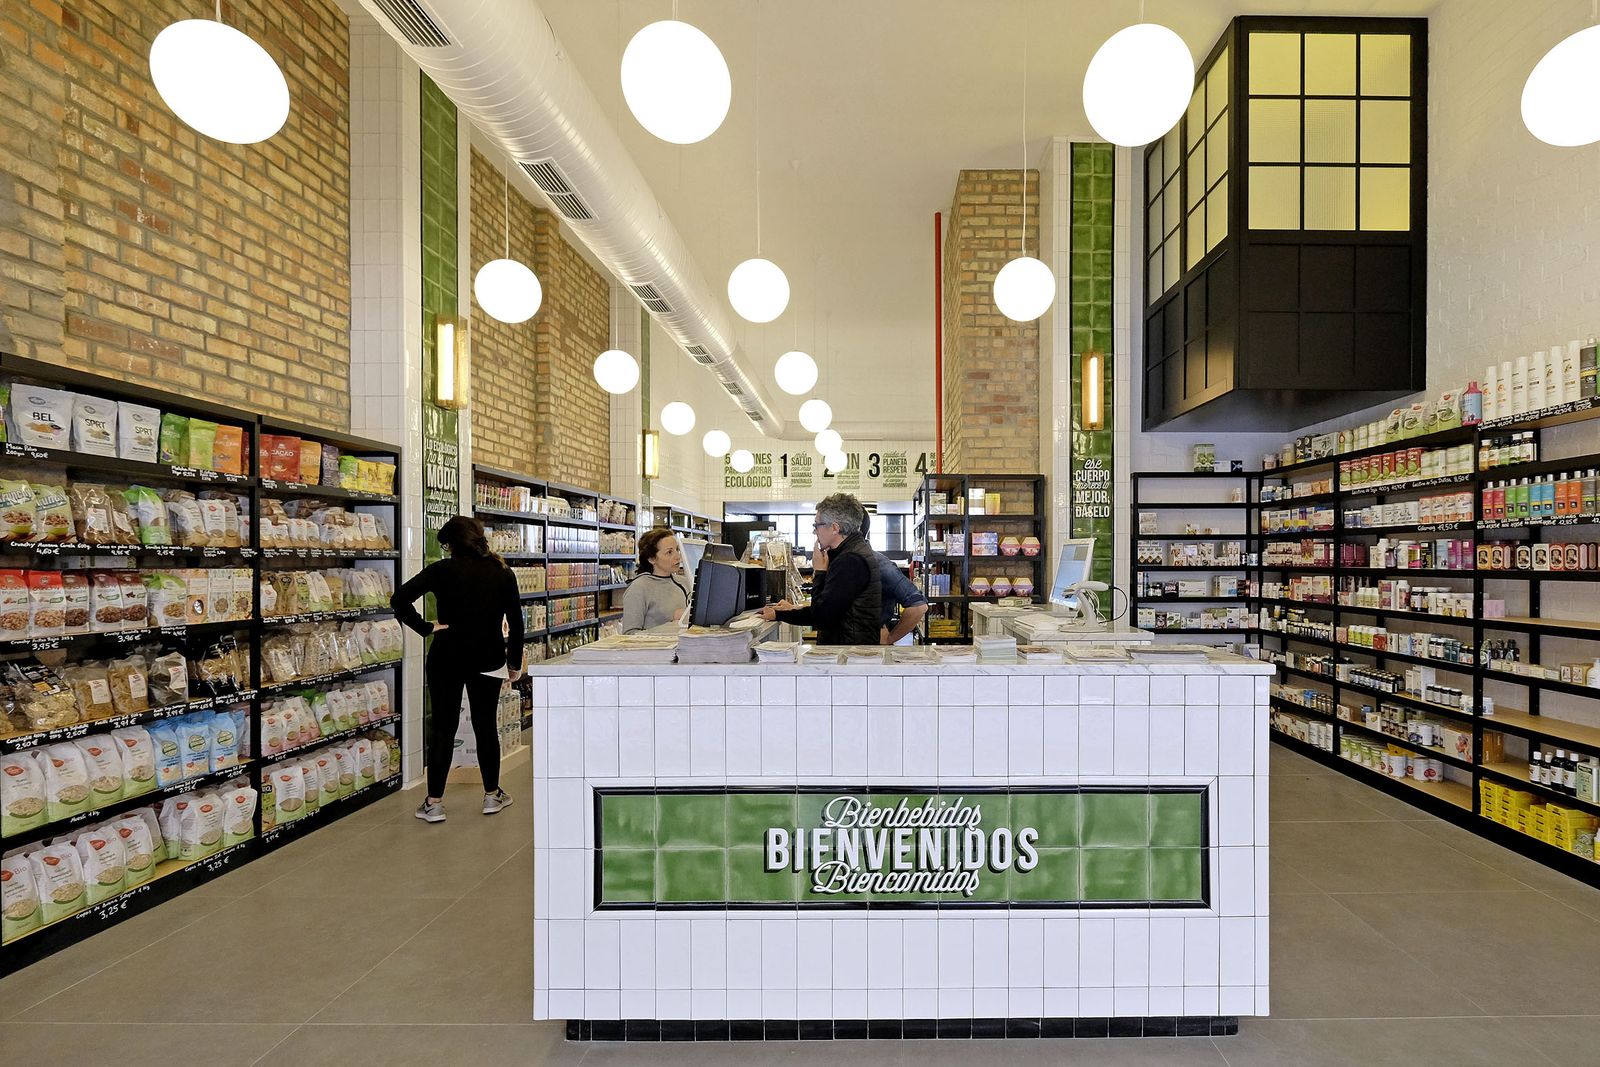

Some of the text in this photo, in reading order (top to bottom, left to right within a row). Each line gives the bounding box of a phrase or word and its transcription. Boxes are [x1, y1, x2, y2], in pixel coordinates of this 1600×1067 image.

[33, 412, 56, 423] BEL
[84, 418, 106, 430] SPRT
[135, 425, 153, 436] SPRT
[780, 453, 788, 478] 1
[791, 457, 812, 466] SALUD
[868, 453, 881, 478] 3
[914, 453, 928, 476] 4
[1084, 459, 1103, 469] ese
[427, 463, 457, 491] MODA
[1075, 470, 1110, 481] CUERPO
[725, 476, 772, 488] ECOLÓGICO
[824, 796, 982, 831] Bienbebidos
[767, 827, 1039, 872] BIENVENIDOS
[14, 866, 28, 875] Bio
[813, 861, 980, 896] Biencomidos
